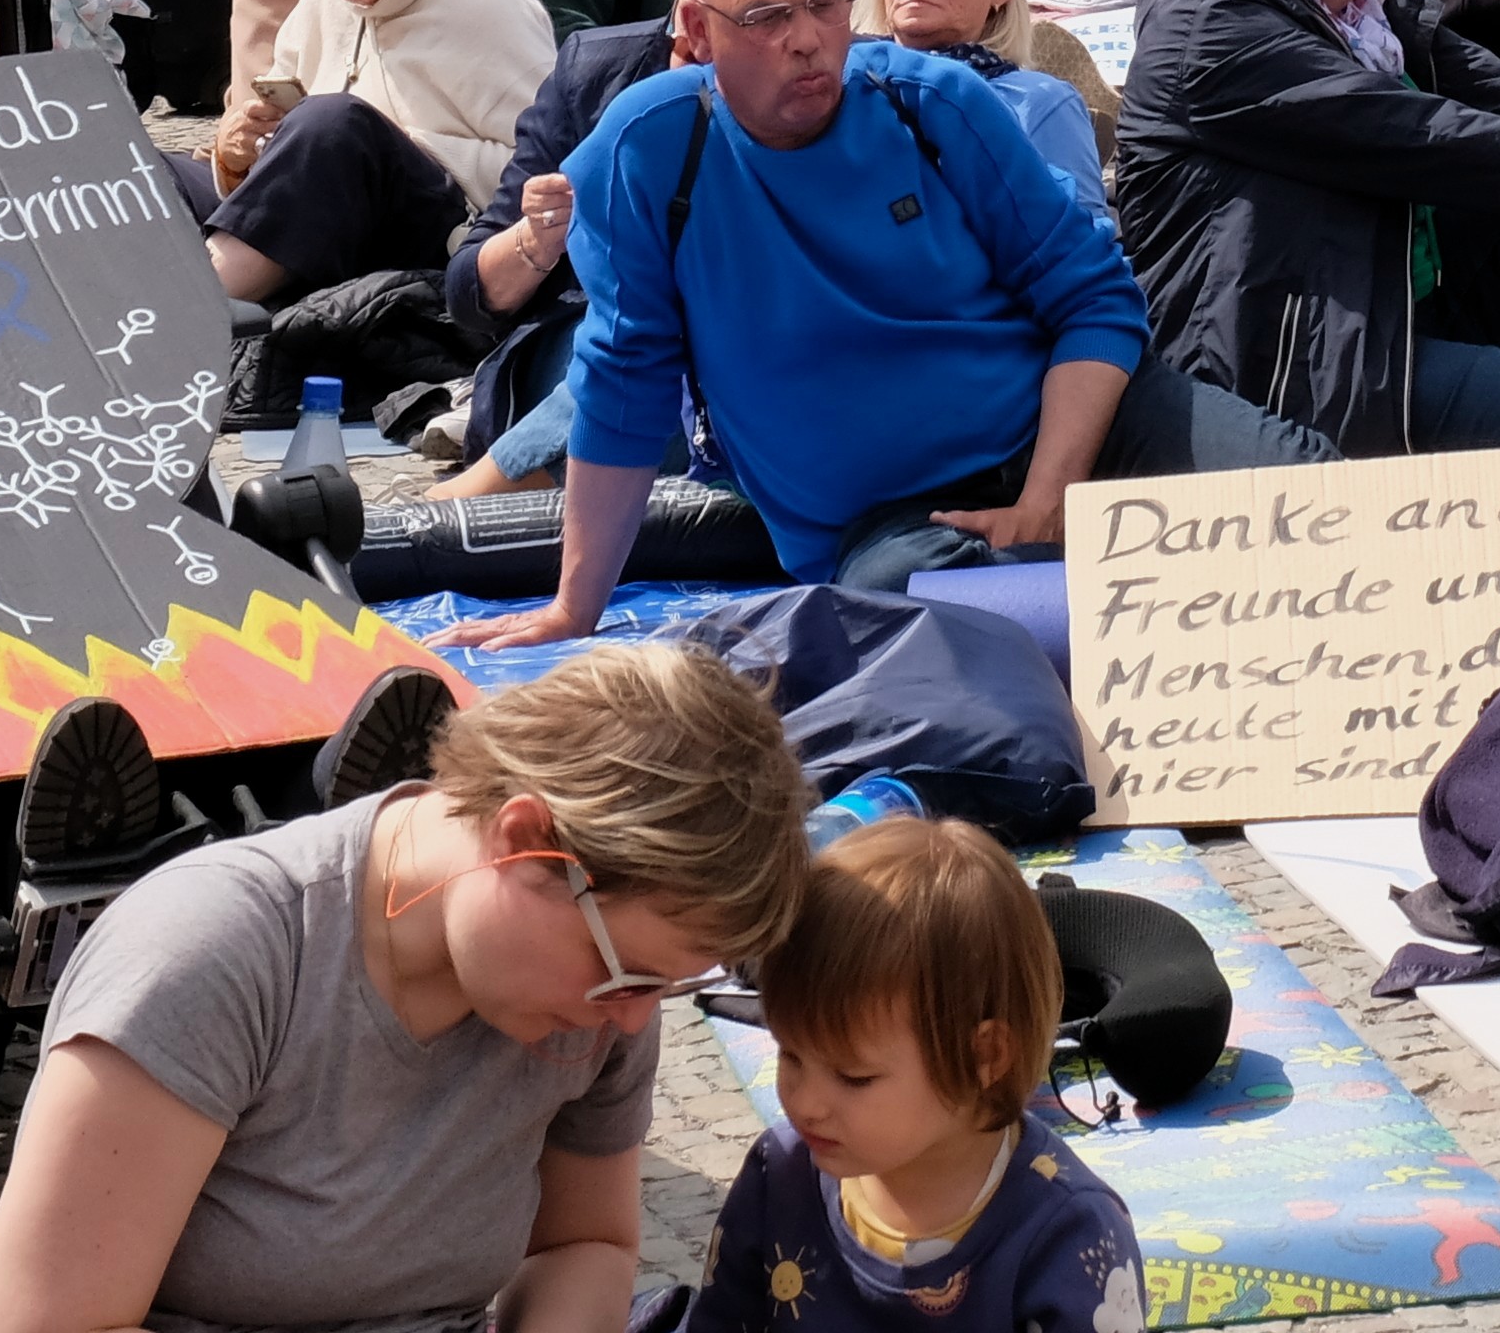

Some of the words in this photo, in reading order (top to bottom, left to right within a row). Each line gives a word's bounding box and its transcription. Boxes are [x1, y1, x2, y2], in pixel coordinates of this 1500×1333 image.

[1096, 491, 1353, 564] Danke
[1384, 496, 1488, 533] an
[1094, 565, 1395, 641] Freunde
[1096, 639, 1454, 708] Menschen,
[1098, 702, 1304, 754] heute
[1343, 684, 1461, 736] mit
[1104, 761, 1260, 800] hier
[1294, 740, 1441, 790] sind
